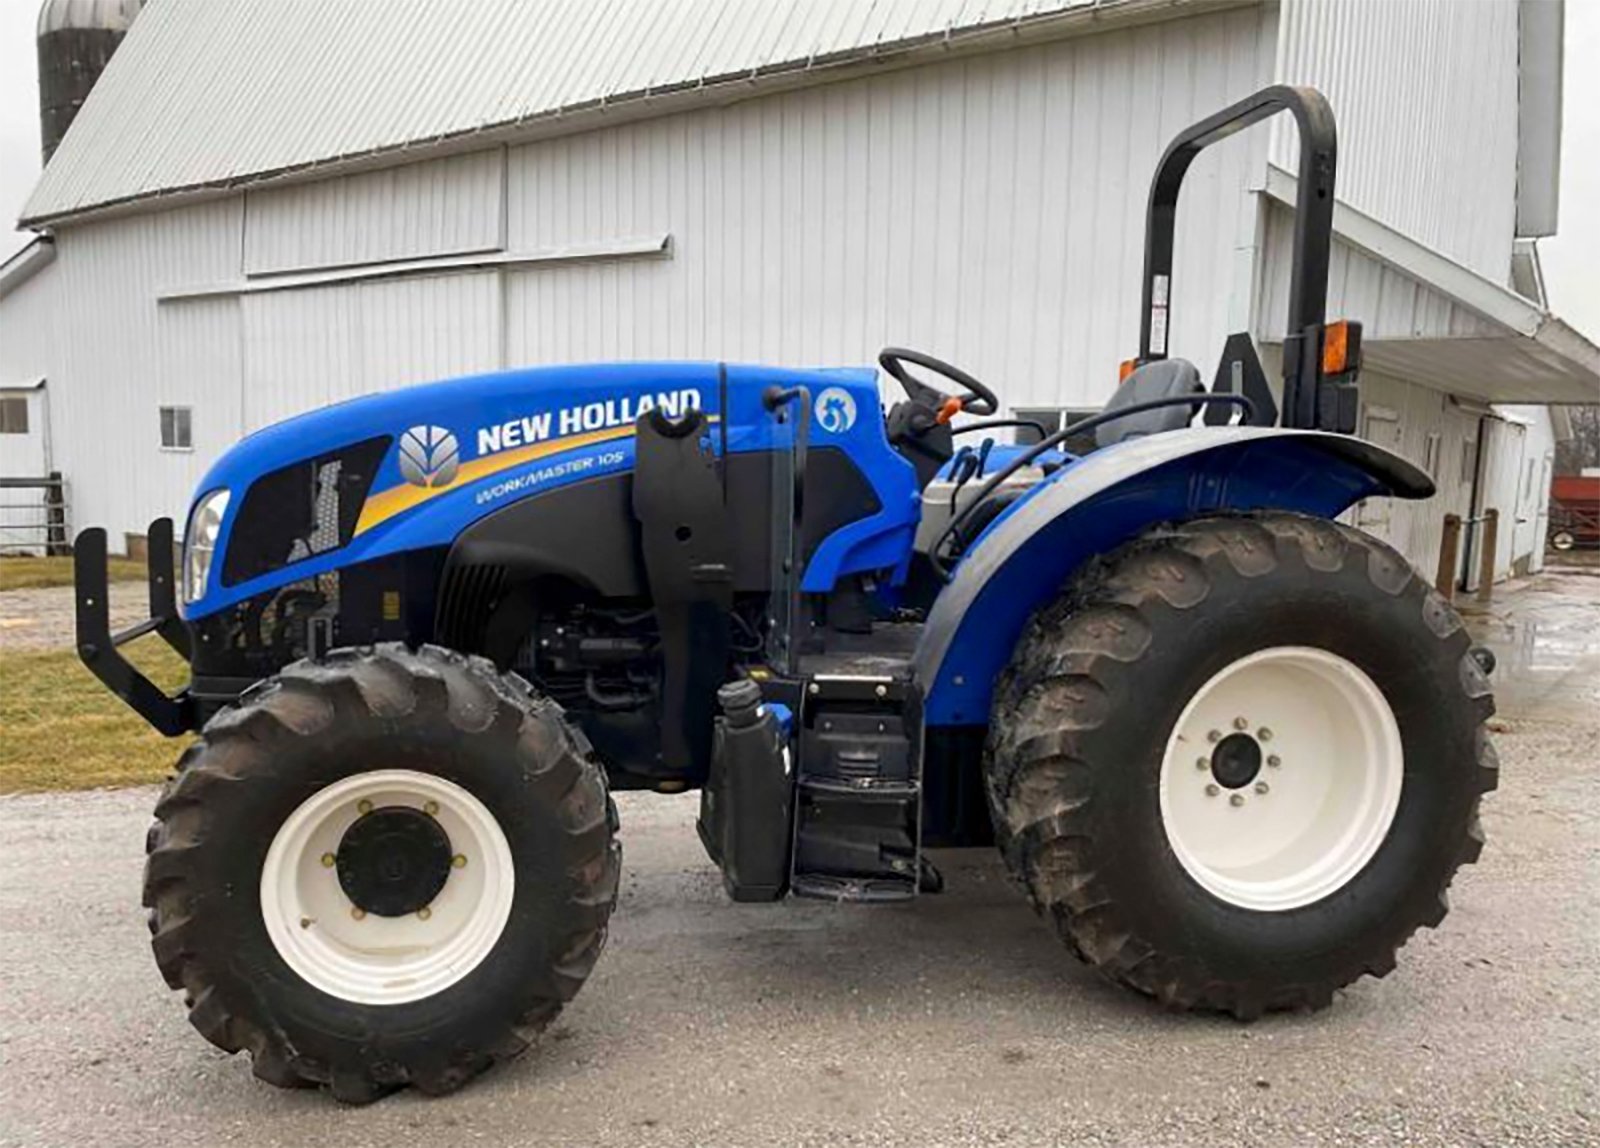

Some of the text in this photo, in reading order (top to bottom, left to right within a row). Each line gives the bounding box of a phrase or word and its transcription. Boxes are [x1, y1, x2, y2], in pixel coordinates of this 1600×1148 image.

[478, 388, 701, 455] NEW HOLLAND
[476, 451, 625, 504] WORKMASTER 105
